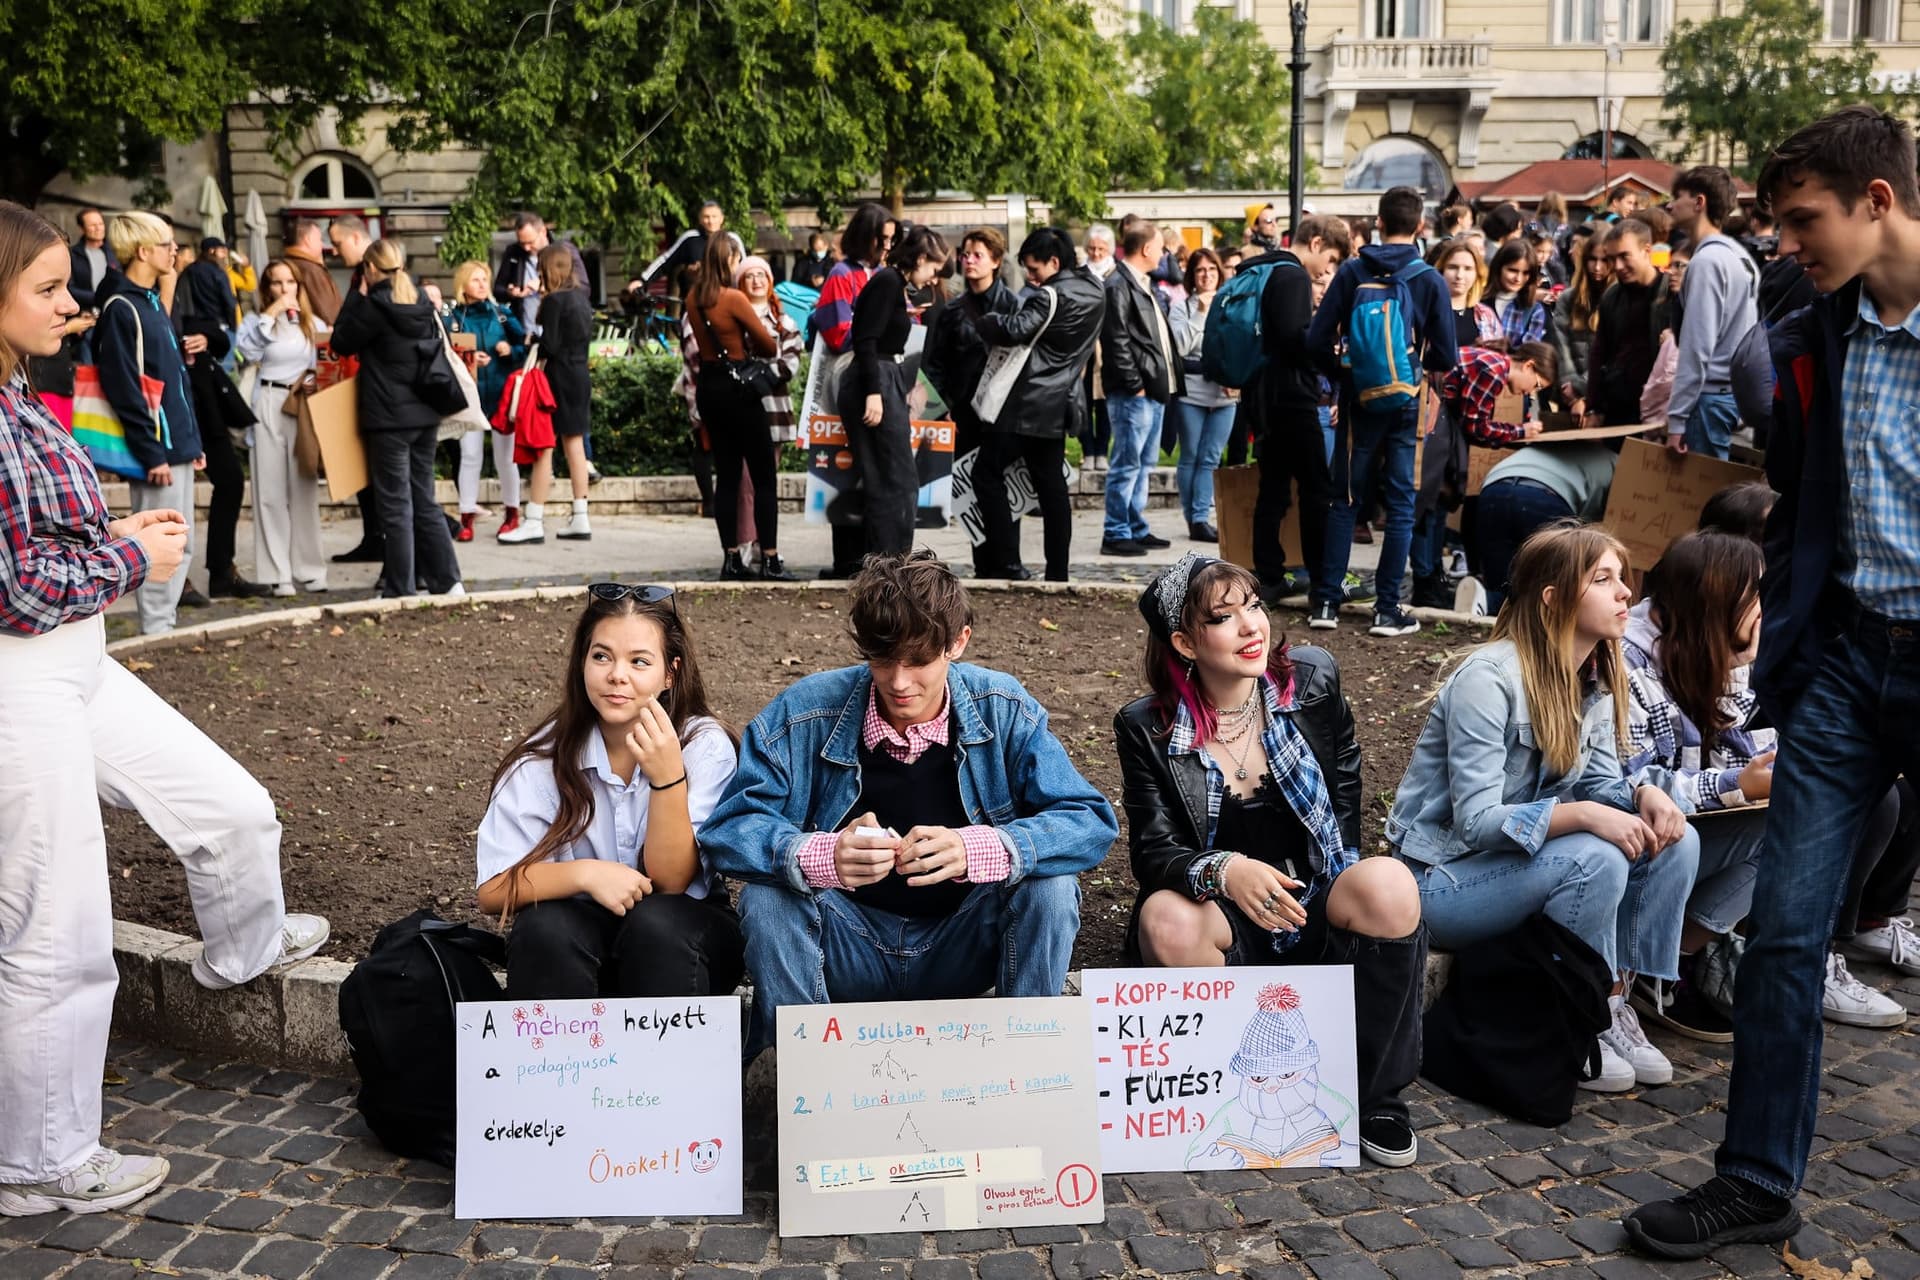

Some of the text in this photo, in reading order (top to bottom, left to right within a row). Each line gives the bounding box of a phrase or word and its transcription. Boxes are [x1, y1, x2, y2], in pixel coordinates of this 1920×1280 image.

[482, 1005, 706, 1041] A méhem helyett
[822, 1017, 842, 1042] A
[858, 1021, 925, 1041] suliban
[938, 1022, 988, 1041] nagyon
[1118, 1015, 1145, 1039] KI
[1160, 1013, 1203, 1037] AZ?
[1121, 1038, 1170, 1067] TÉS
[485, 1052, 618, 1087] a pedagógusok
[592, 1087, 661, 1110] fizetése
[824, 1092, 832, 1111] A
[853, 1088, 926, 1108] tanáraink
[484, 1118, 567, 1146] érdekelje
[589, 1148, 681, 1183] Önöket!
[820, 1164, 848, 1183] Ezt
[858, 1162, 874, 1178] ti
[984, 1186, 1046, 1201] Olvasd egybe
[998, 1202, 1020, 1212] piros
